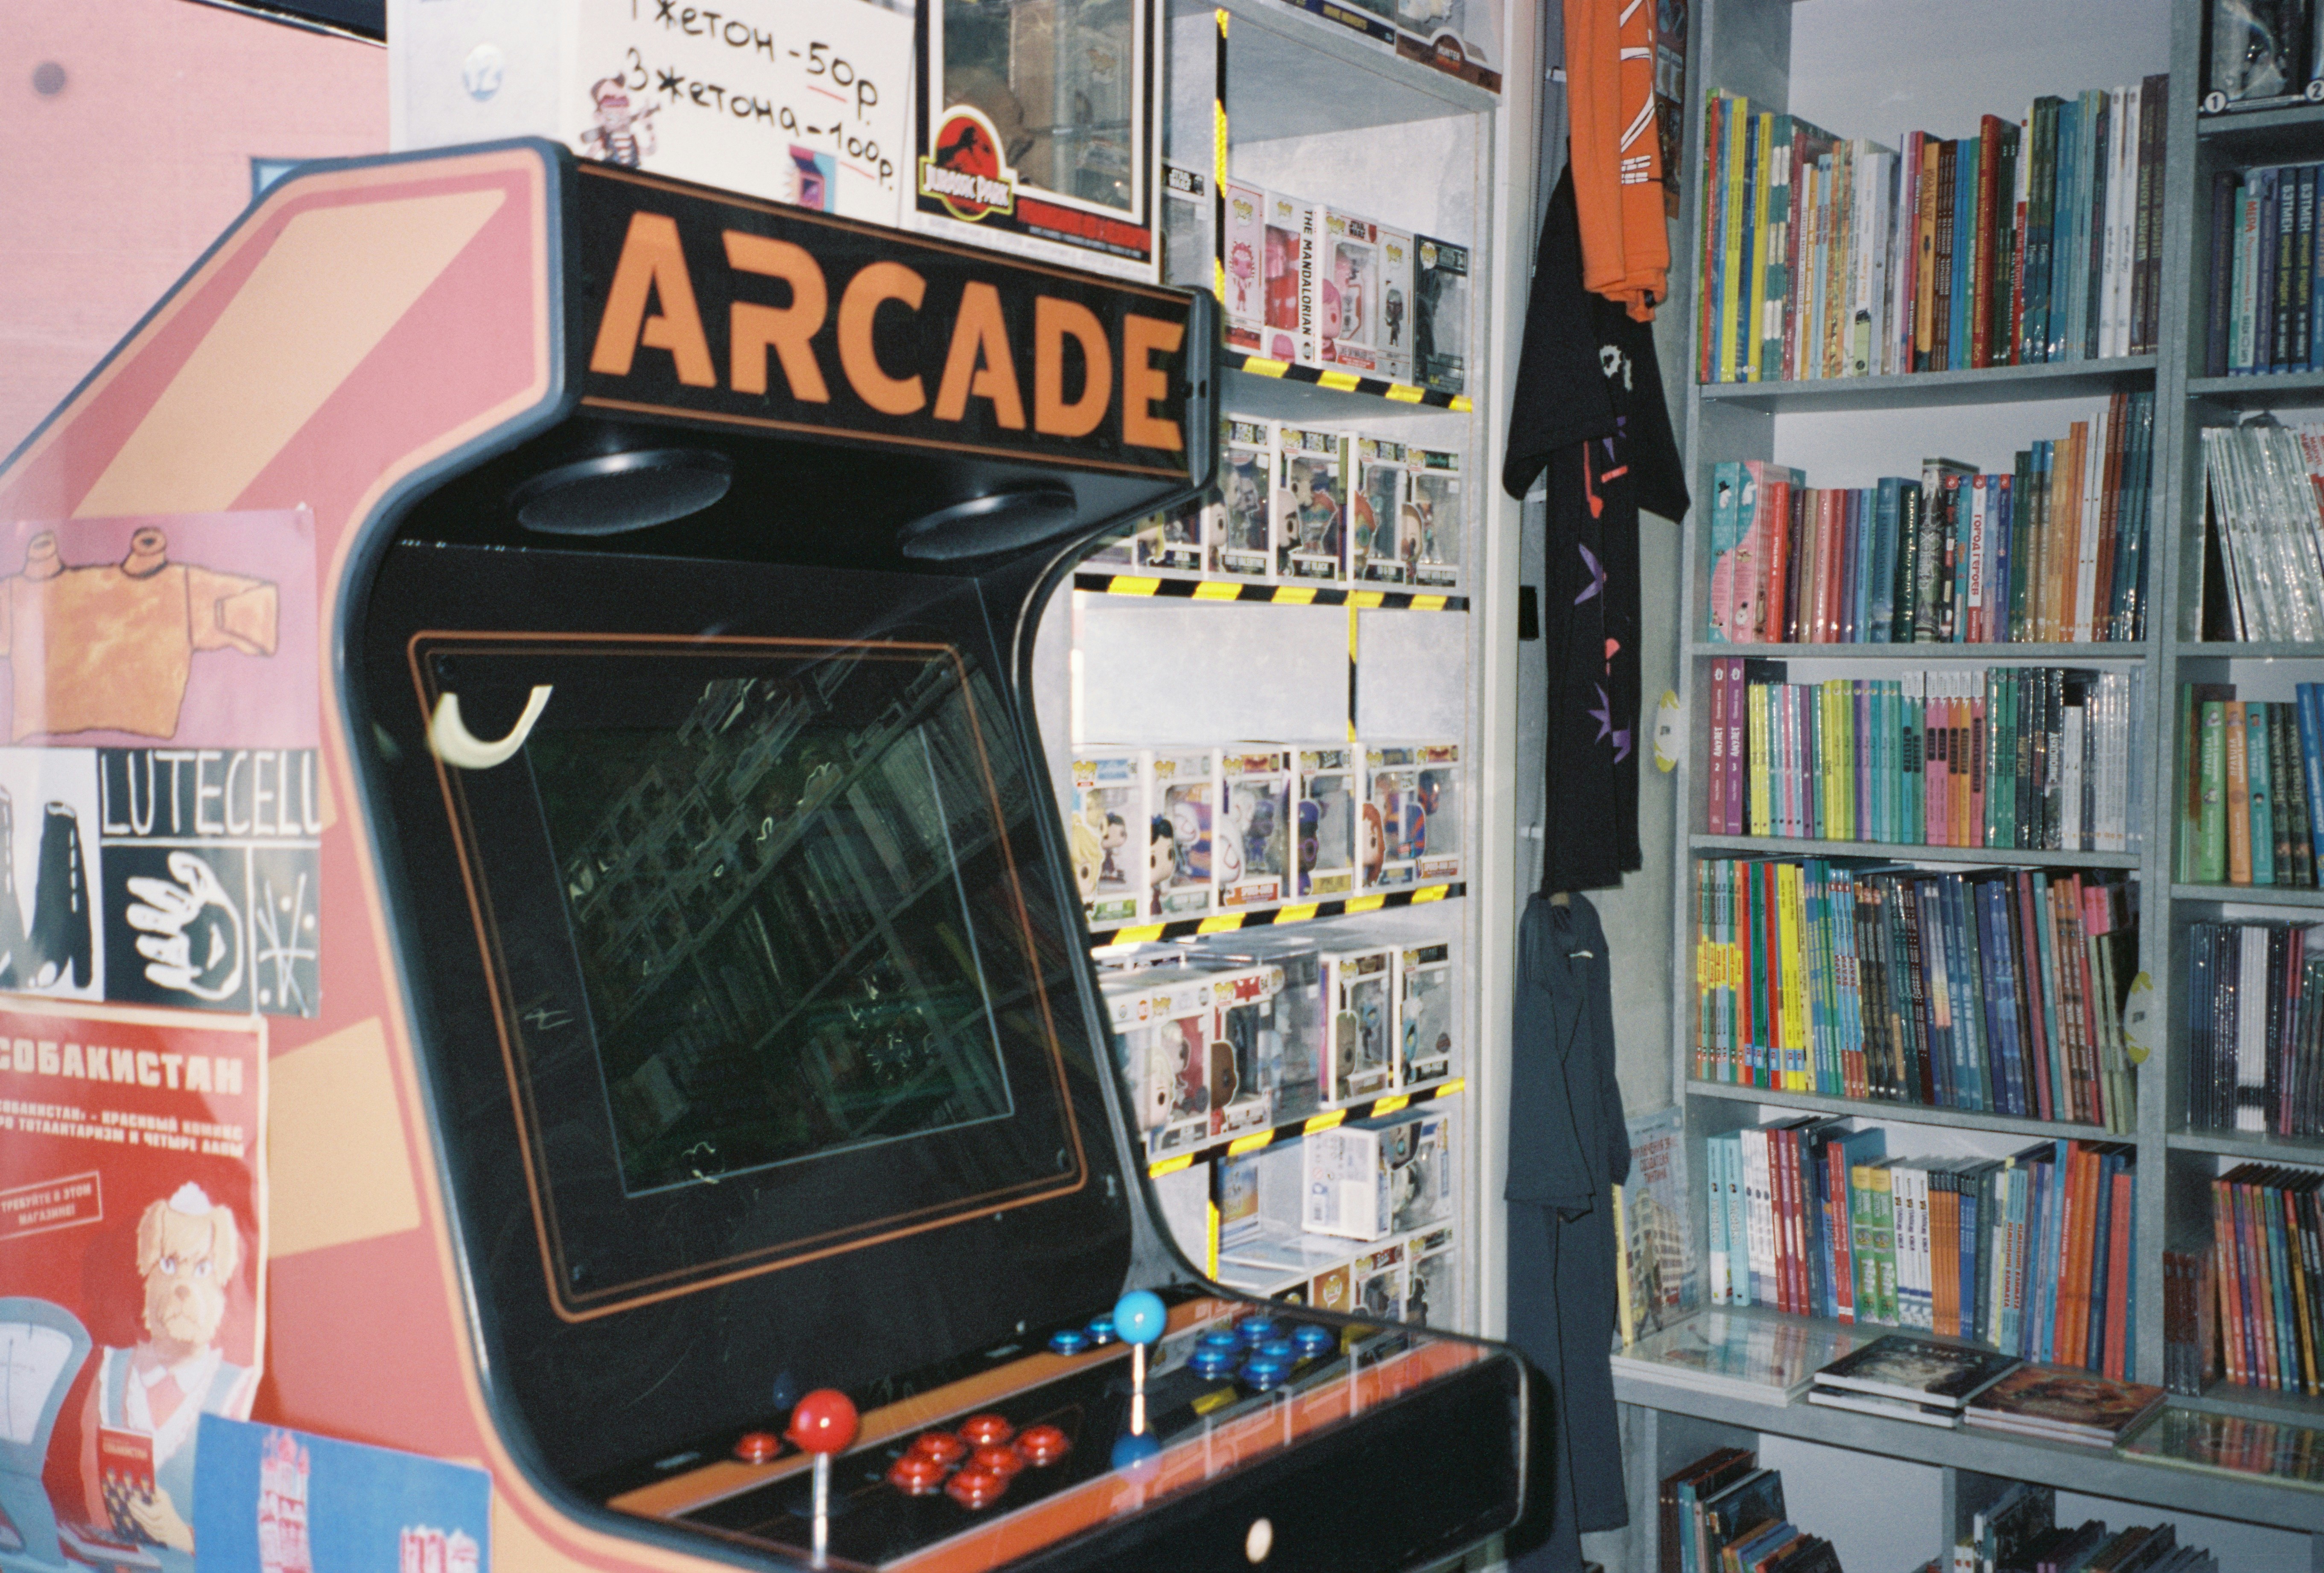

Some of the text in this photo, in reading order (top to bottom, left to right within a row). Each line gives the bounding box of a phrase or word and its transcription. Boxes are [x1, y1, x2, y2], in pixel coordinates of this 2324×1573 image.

[627, 47, 648, 91] 3
[657, 65, 800, 137] жетона
[1169, 169, 1190, 181] STAR
[1170, 178, 1191, 191] WARS
[2281, 185, 2294, 233] БЭТМЕН
[2301, 184, 2312, 231] БЭТМЕН
[1302, 209, 1313, 336] THE MANDALORIAN
[589, 211, 1184, 451] ARCADE
[1971, 514, 1982, 595] ГОРОД ГЕРОЕВ
[1714, 727, 1723, 757] АМУЛЕТ
[1730, 727, 1740, 757] АМУЛЕТ
[2229, 738, 2237, 776] ПРАВИЛА
[1715, 762, 1720, 771] 2
[1732, 762, 1737, 771] 3
[129, 1130, 139, 1145] И
[2003, 1222, 2014, 1307] ИЗМЕНЕНИЕ КЛИМАТА
[2015, 1223, 2023, 1269] ИЗМЕНЕНИЕ
